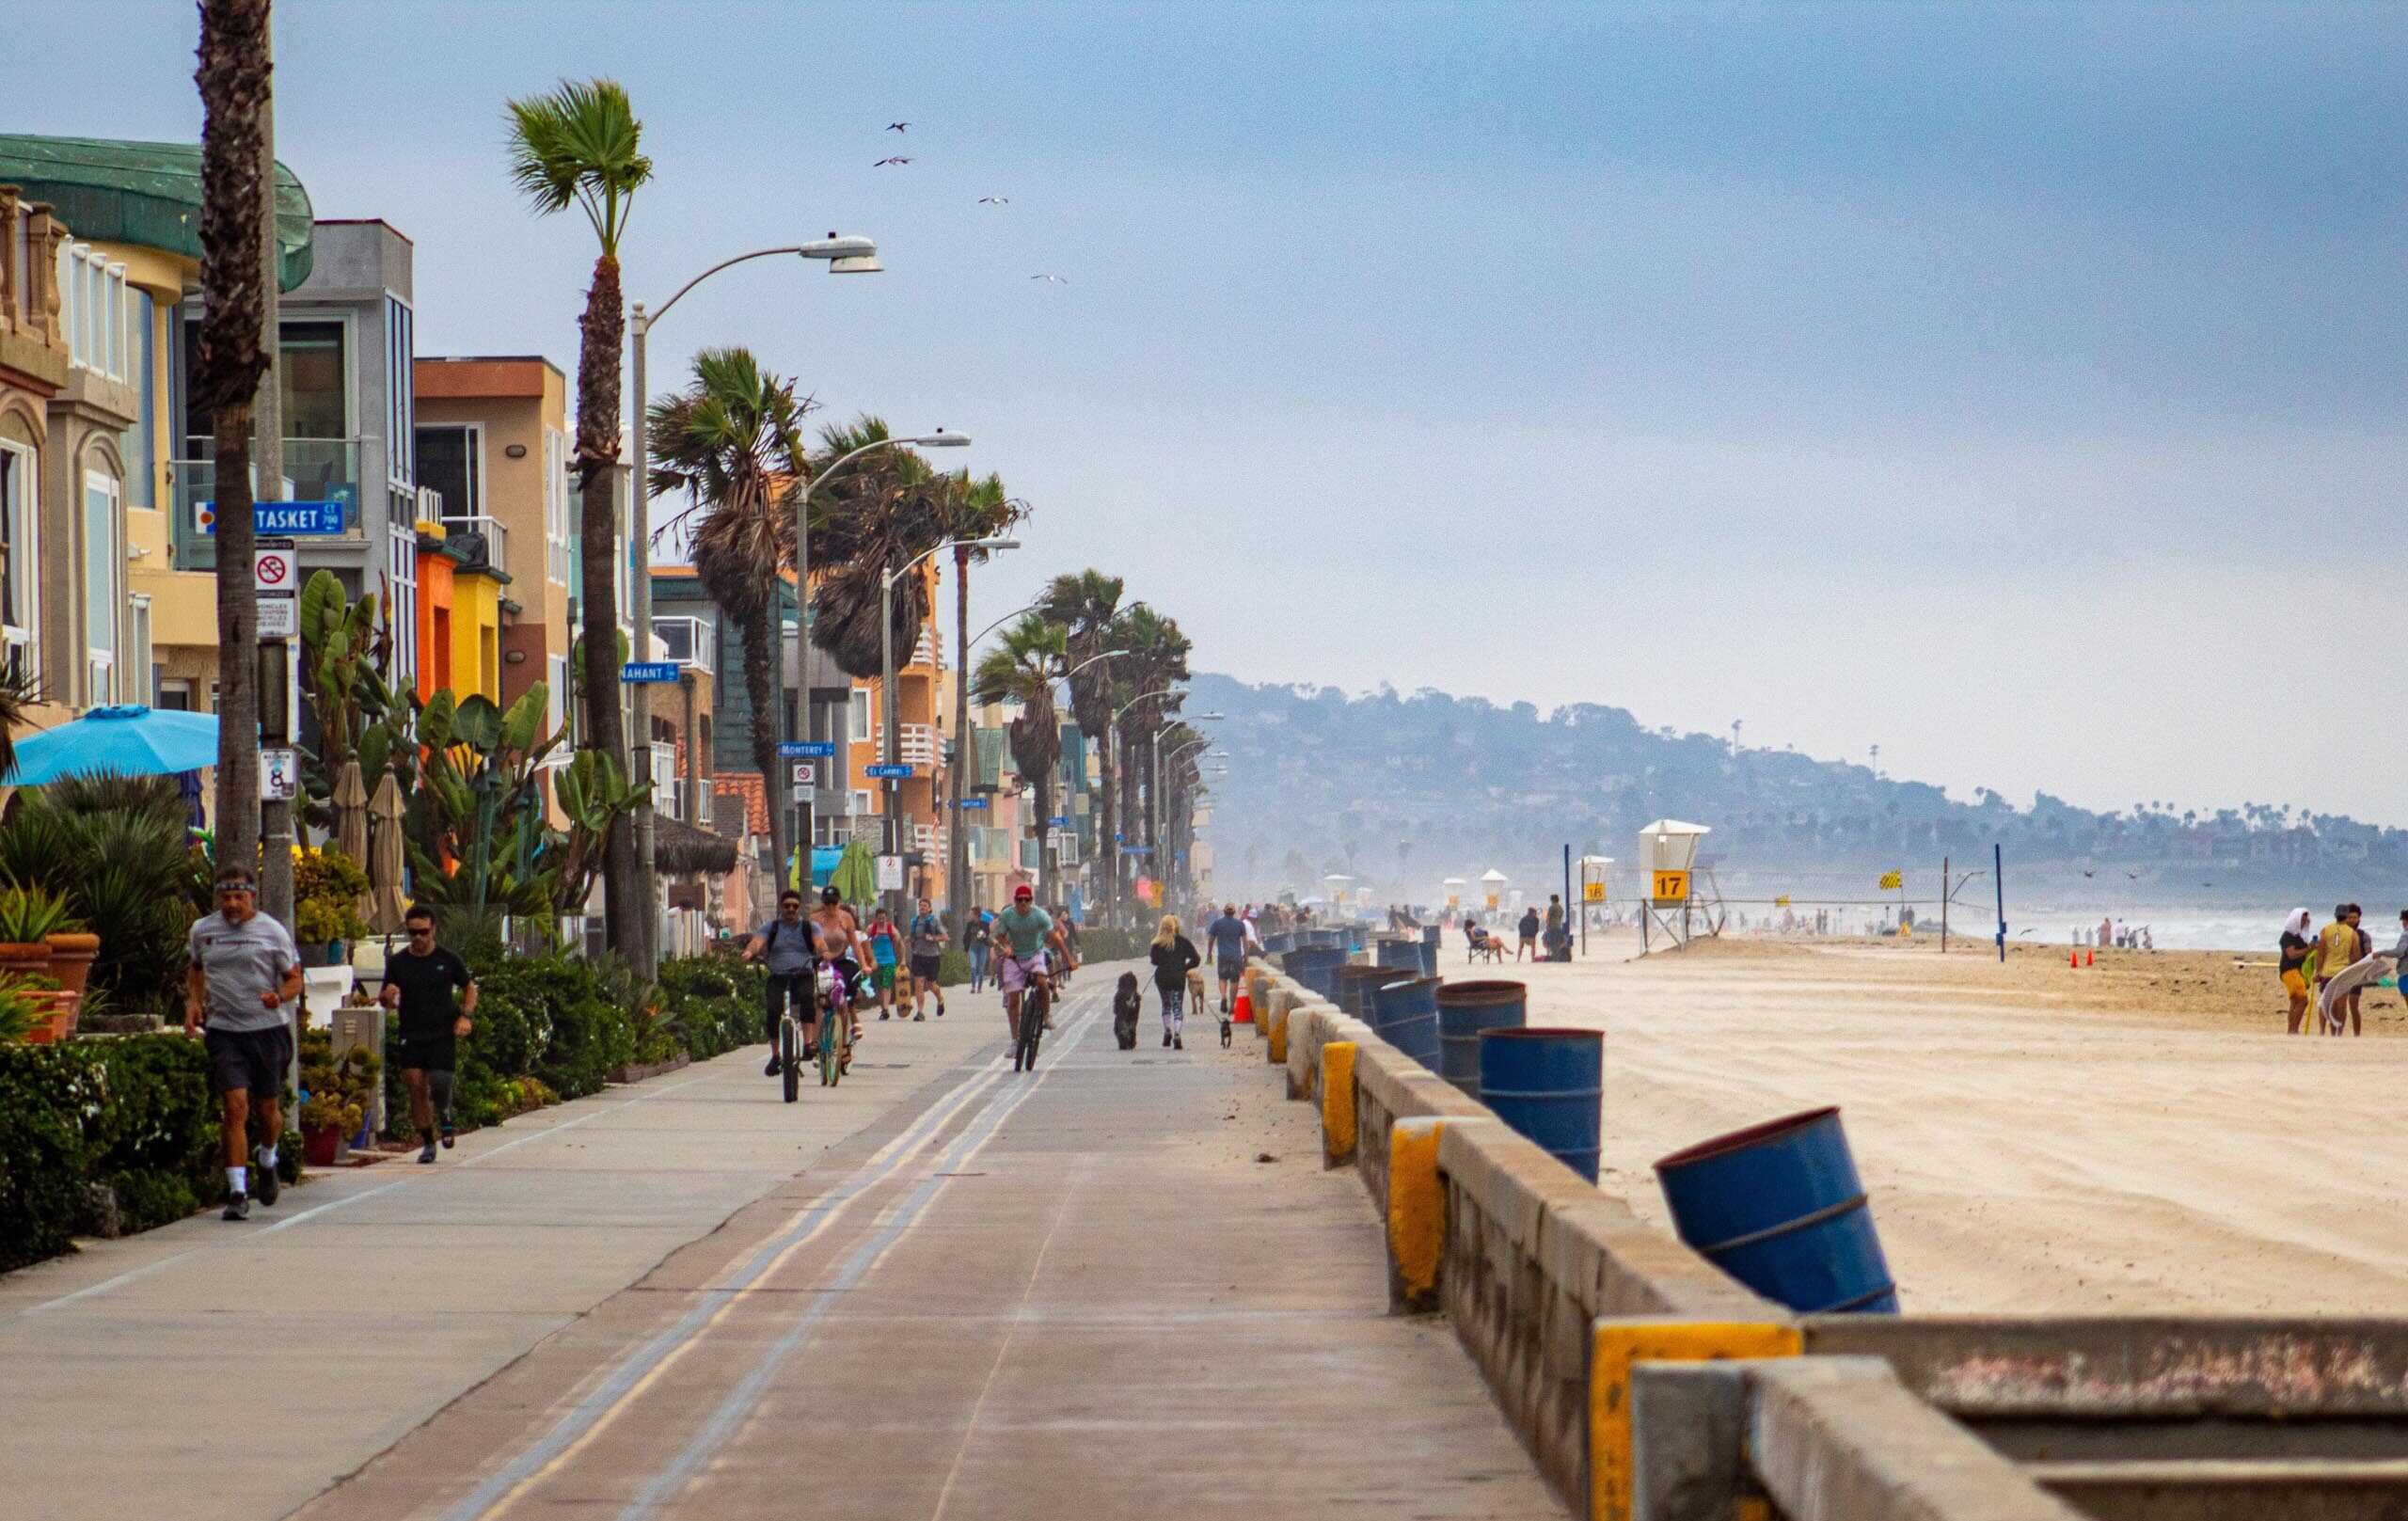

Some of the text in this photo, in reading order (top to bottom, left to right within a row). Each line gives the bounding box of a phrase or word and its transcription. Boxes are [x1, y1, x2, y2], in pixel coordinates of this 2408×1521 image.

[324, 503, 336, 514] CT
[257, 510, 318, 529] TASKET
[620, 667, 662, 679] NAHANT
[782, 744, 823, 755] MONTEREY
[1657, 877, 1682, 895] 17
